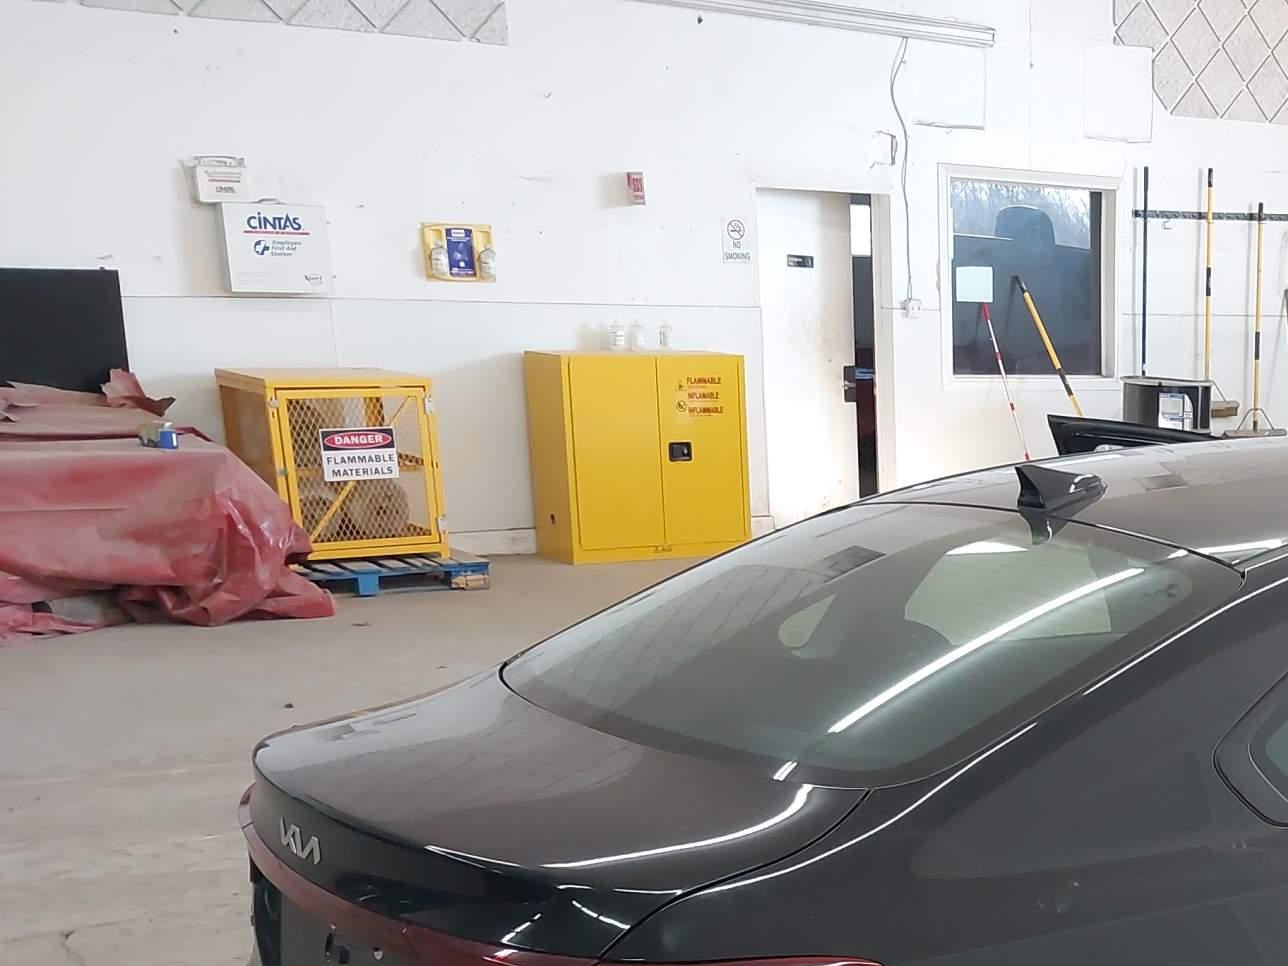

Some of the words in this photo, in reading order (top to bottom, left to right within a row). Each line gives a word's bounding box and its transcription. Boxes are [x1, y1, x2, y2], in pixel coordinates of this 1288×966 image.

[732, 240, 742, 249] NO
[724, 252, 751, 261] SMOKING
[687, 376, 721, 384] FLAMMABLE
[334, 434, 384, 445] DANGER
[326, 454, 395, 465] FLAMMABLE
[332, 466, 393, 477] MATERIALS
[280, 816, 321, 864] KIA
